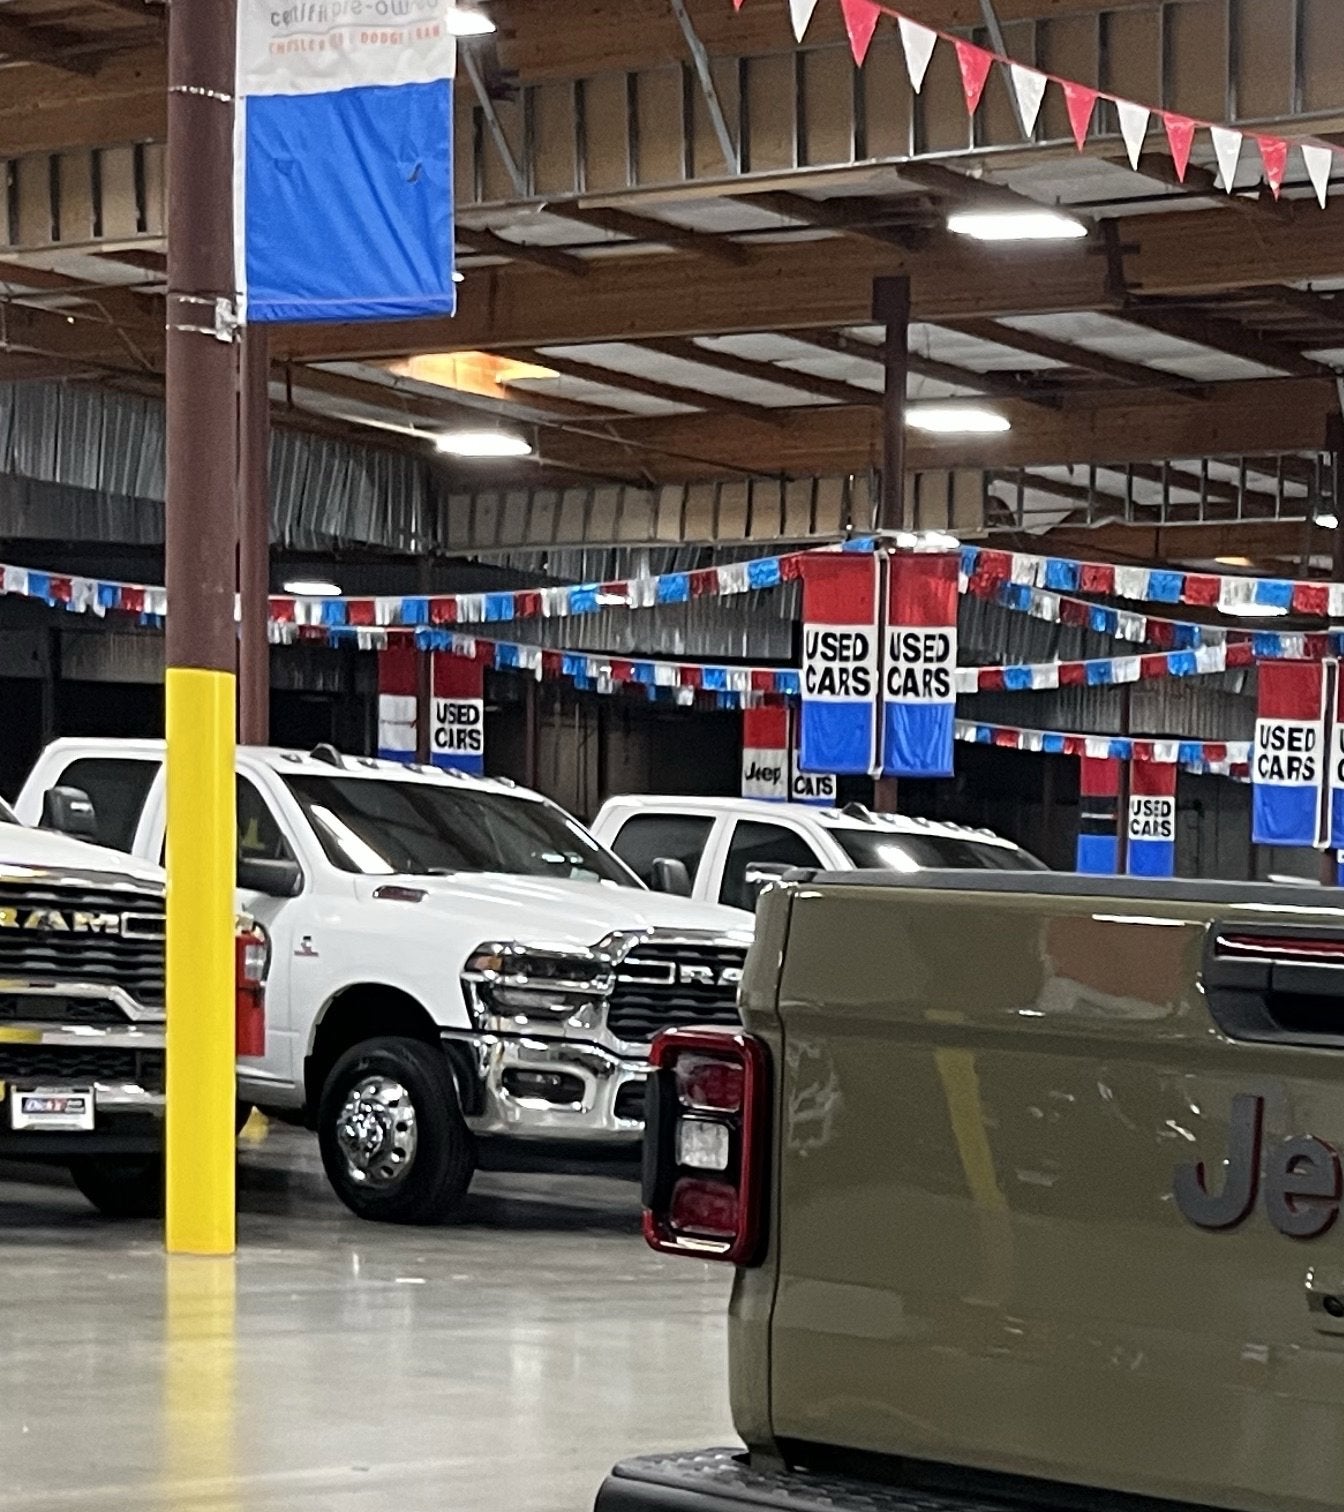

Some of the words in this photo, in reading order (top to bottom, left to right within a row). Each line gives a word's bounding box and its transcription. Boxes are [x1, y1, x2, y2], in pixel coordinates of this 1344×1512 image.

[806, 630, 869, 662] USED
[889, 632, 950, 663] USED
[805, 664, 872, 697] CARS
[887, 666, 951, 698] CARS
[436, 701, 480, 725] USED
[1260, 725, 1316, 752] USED
[744, 761, 782, 785] Jeep
[1257, 754, 1316, 781] CARS
[1131, 799, 1172, 817] USED
[1130, 818, 1172, 837] CARS
